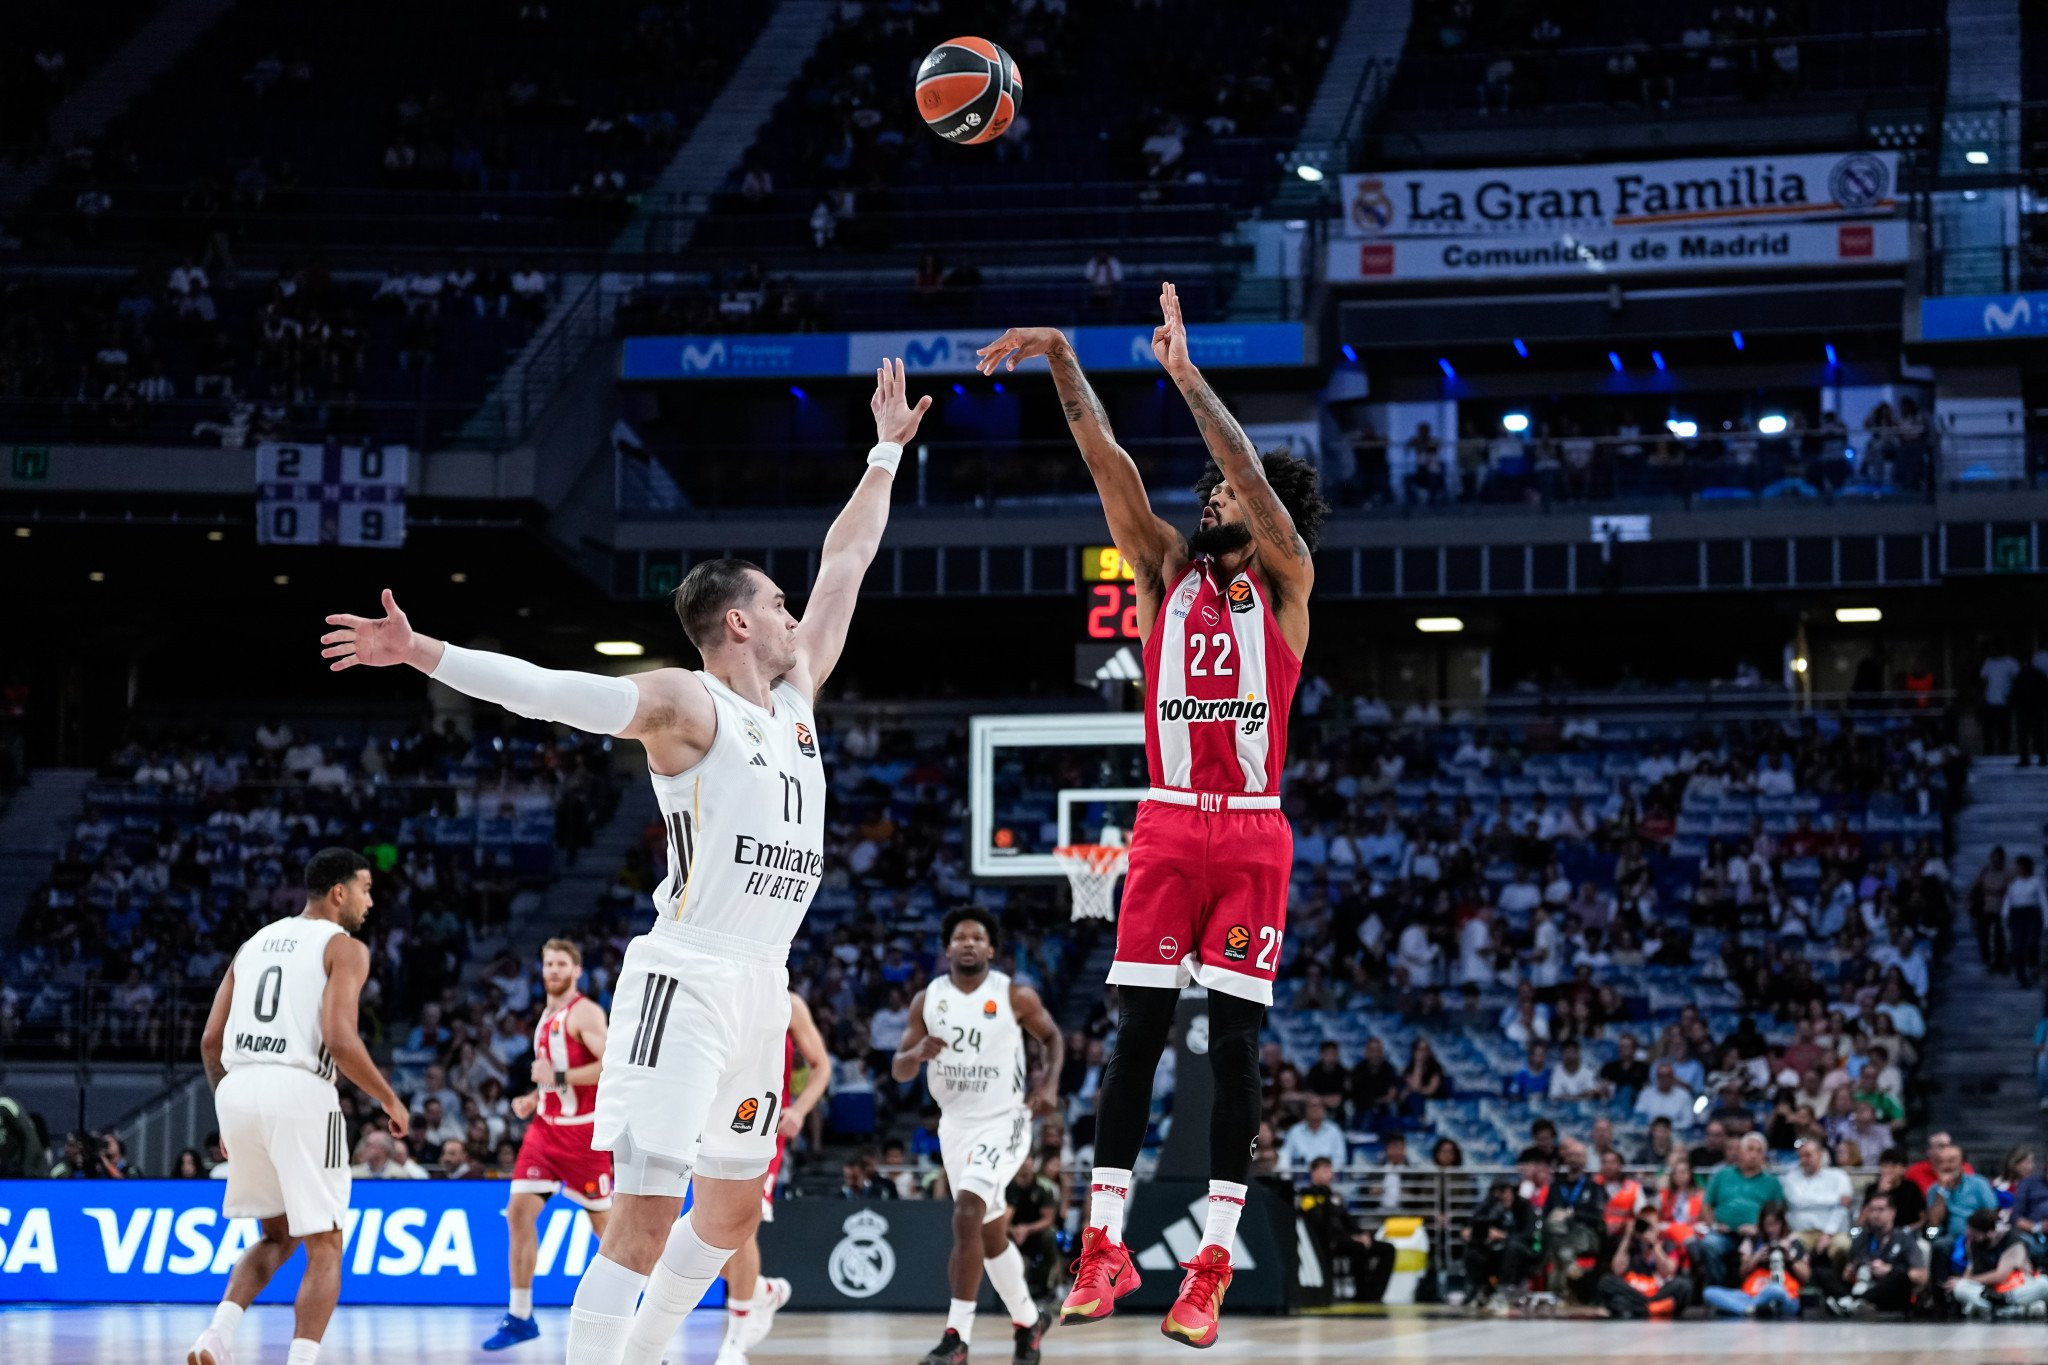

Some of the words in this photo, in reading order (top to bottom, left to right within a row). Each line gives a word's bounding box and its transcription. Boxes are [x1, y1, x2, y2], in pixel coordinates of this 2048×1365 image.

[1407, 182, 1464, 221] La
[1476, 180, 1602, 220] Gran
[1615, 166, 1808, 217] Familia
[1443, 238, 1619, 267] Comunidad
[1629, 239, 1668, 260] de
[1680, 232, 1790, 258] Madrid
[277, 448, 300, 476] 2
[361, 450, 383, 478] 0
[274, 507, 298, 537] 0
[361, 509, 383, 540] 9
[1190, 633, 1233, 676] 22
[1158, 693, 1267, 721] 100xronia
[1241, 720, 1264, 735] .gr
[779, 770, 802, 824] 11
[1201, 793, 1223, 813] OLY
[735, 834, 824, 878] Emirates
[745, 871, 772, 896] FLY
[262, 939, 298, 953] LYLES
[254, 965, 282, 1023] 0
[236, 1033, 287, 1055] MADRID
[952, 1027, 981, 1053] 24
[936, 1060, 1000, 1080] Emirates
[760, 1091, 783, 1136] 1
[973, 1144, 1000, 1171] 24
[0, 1207, 58, 1273] A
[82, 1207, 264, 1275] VISA
